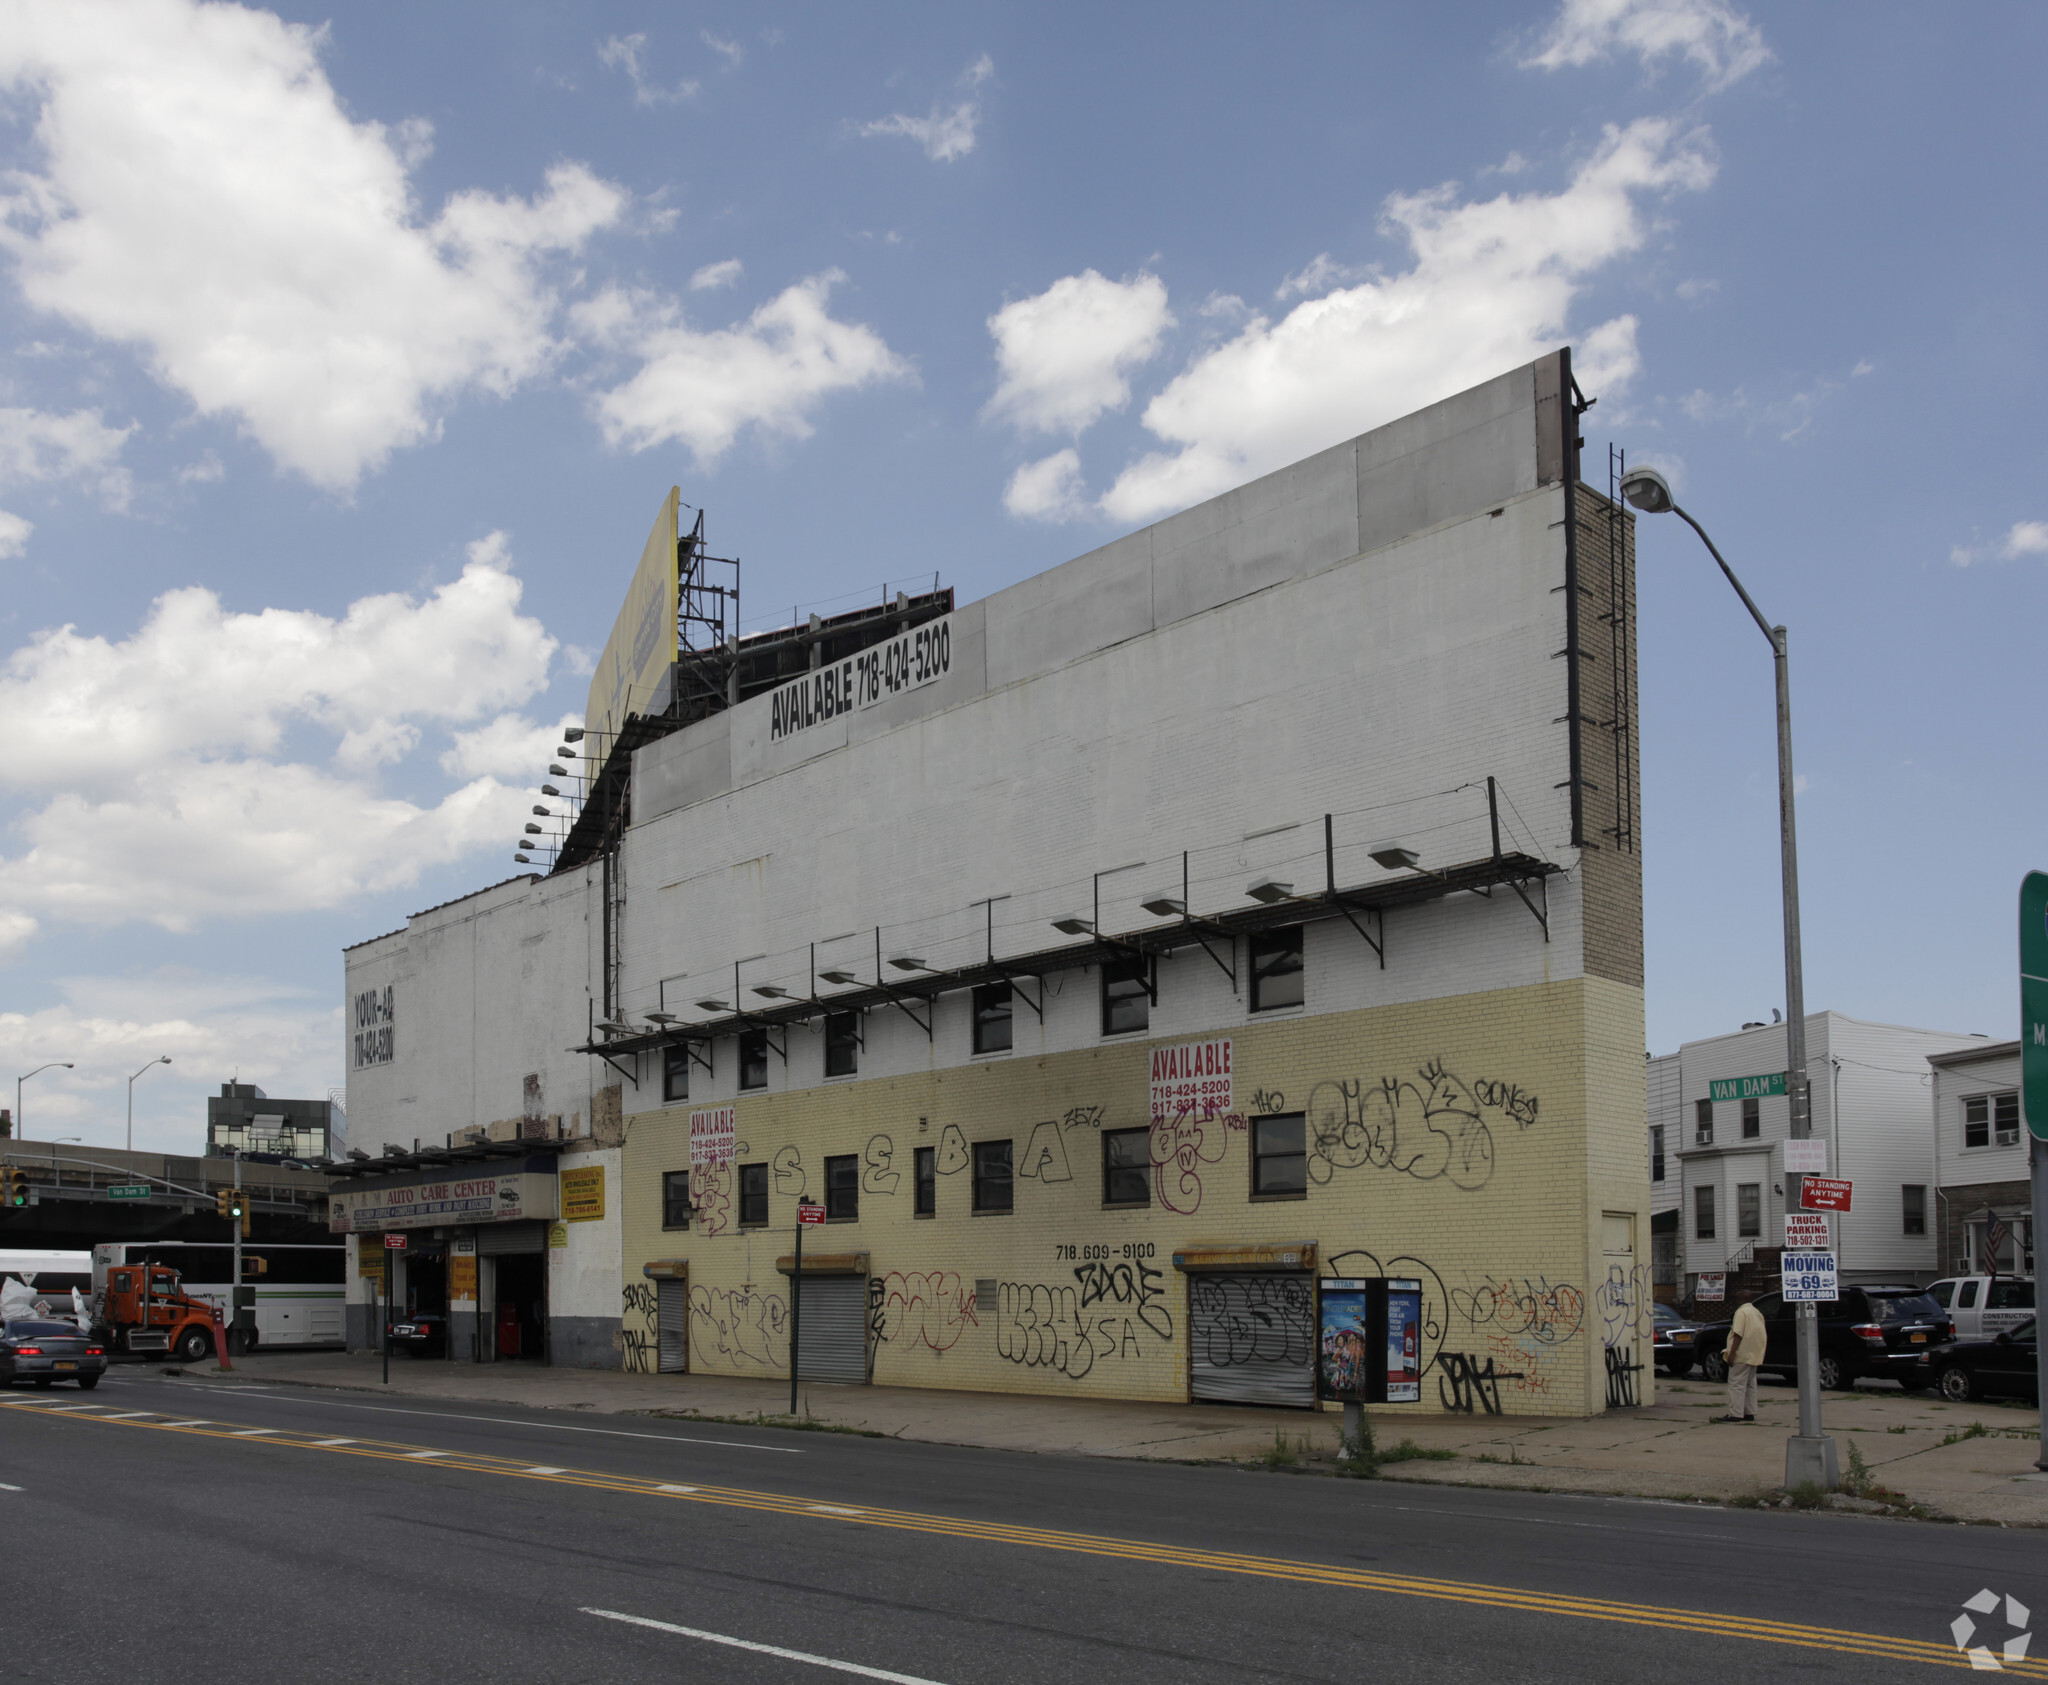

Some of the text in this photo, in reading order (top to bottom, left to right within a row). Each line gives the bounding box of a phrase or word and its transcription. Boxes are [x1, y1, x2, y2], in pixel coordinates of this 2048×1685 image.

[771, 621, 949, 740] AVAILABLE 718-424-5200
[354, 985, 394, 1029] YOUR-AD
[2034, 1022, 2046, 1046] M
[1152, 1042, 1230, 1082] AVAILABLE
[1152, 1079, 1230, 1099] 718-424-5200
[1714, 1075, 1784, 1098] VAN DAM ST
[691, 1109, 734, 1137] AVAILABLE
[691, 1137, 734, 1150] 718-424-5200
[387, 1189, 414, 1205] AUTO
[421, 1184, 448, 1200] CARE
[454, 1180, 496, 1198] CENTER
[1810, 1189, 1844, 1198] ANYTIME
[1818, 1181, 1850, 1190] STANDING
[1787, 1225, 1827, 1234] PARKING
[1791, 1216, 1822, 1224] TRUCK
[1787, 1235, 1828, 1245] 718-502-1311
[1056, 1242, 1155, 1260] 718.609-9100
[1784, 1258, 1834, 1271] MOVING
